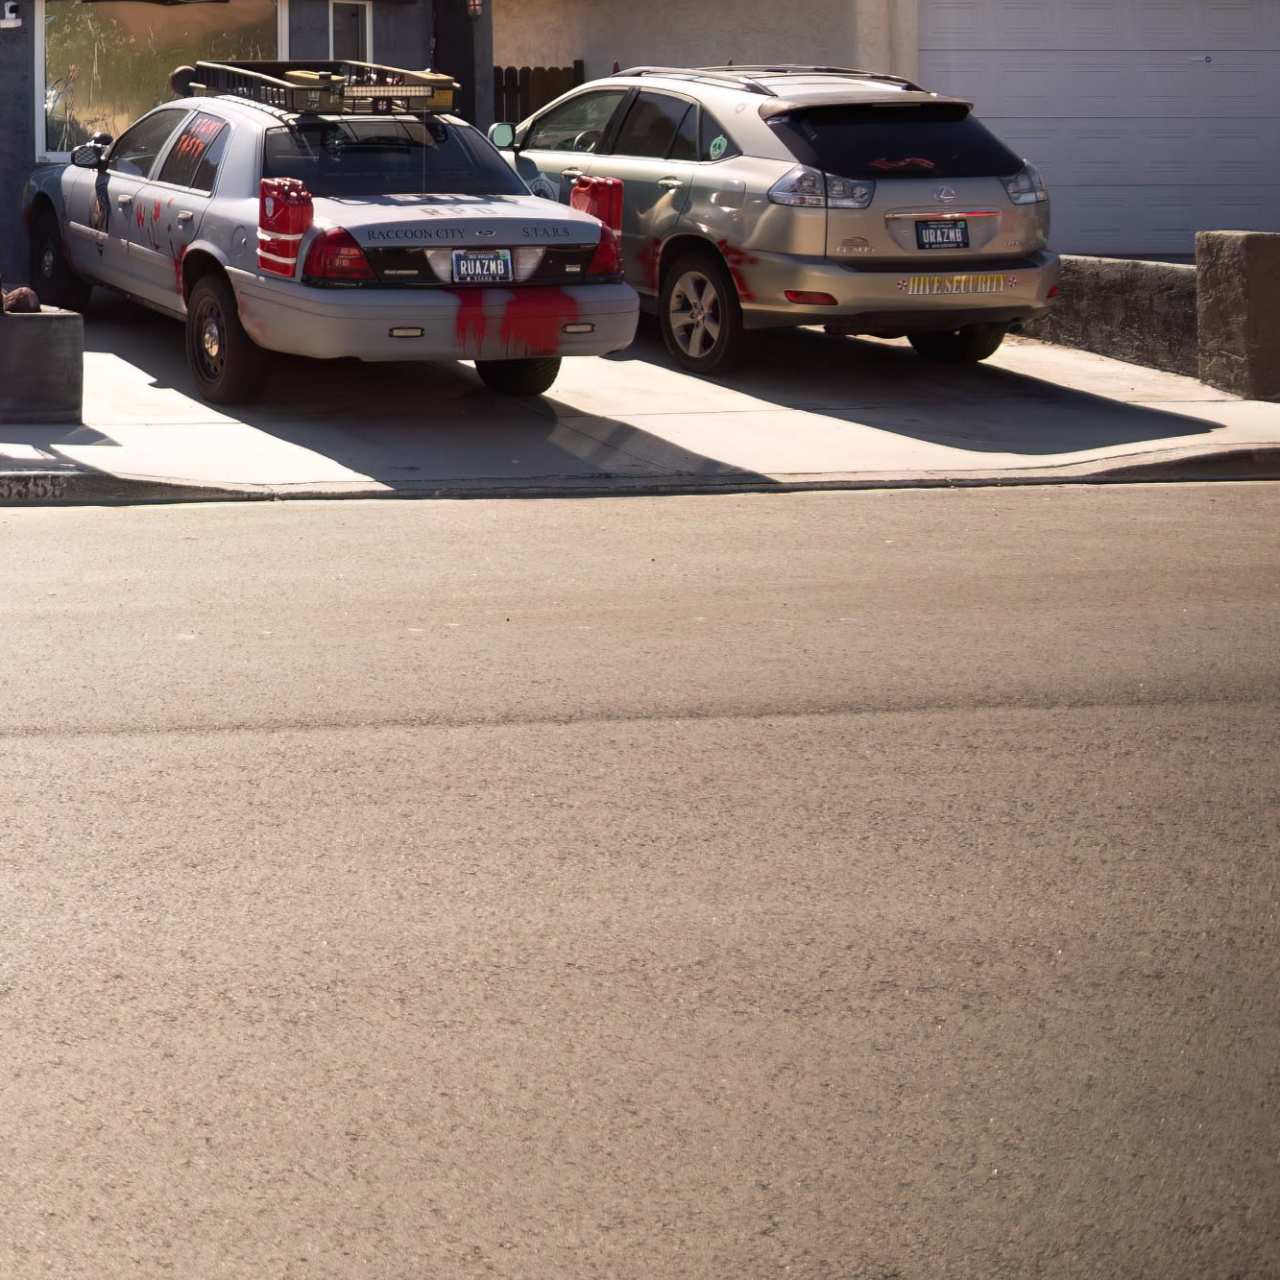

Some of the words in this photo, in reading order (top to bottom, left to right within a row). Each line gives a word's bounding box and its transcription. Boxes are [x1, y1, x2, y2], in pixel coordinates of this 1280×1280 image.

[367, 229, 433, 240] RACCOON
[435, 228, 465, 239] CITY
[922, 228, 963, 243] URAZMB
[460, 259, 505, 275] RUAZMB
[908, 276, 942, 295] HIVE
[943, 274, 1008, 294] SECURITY
